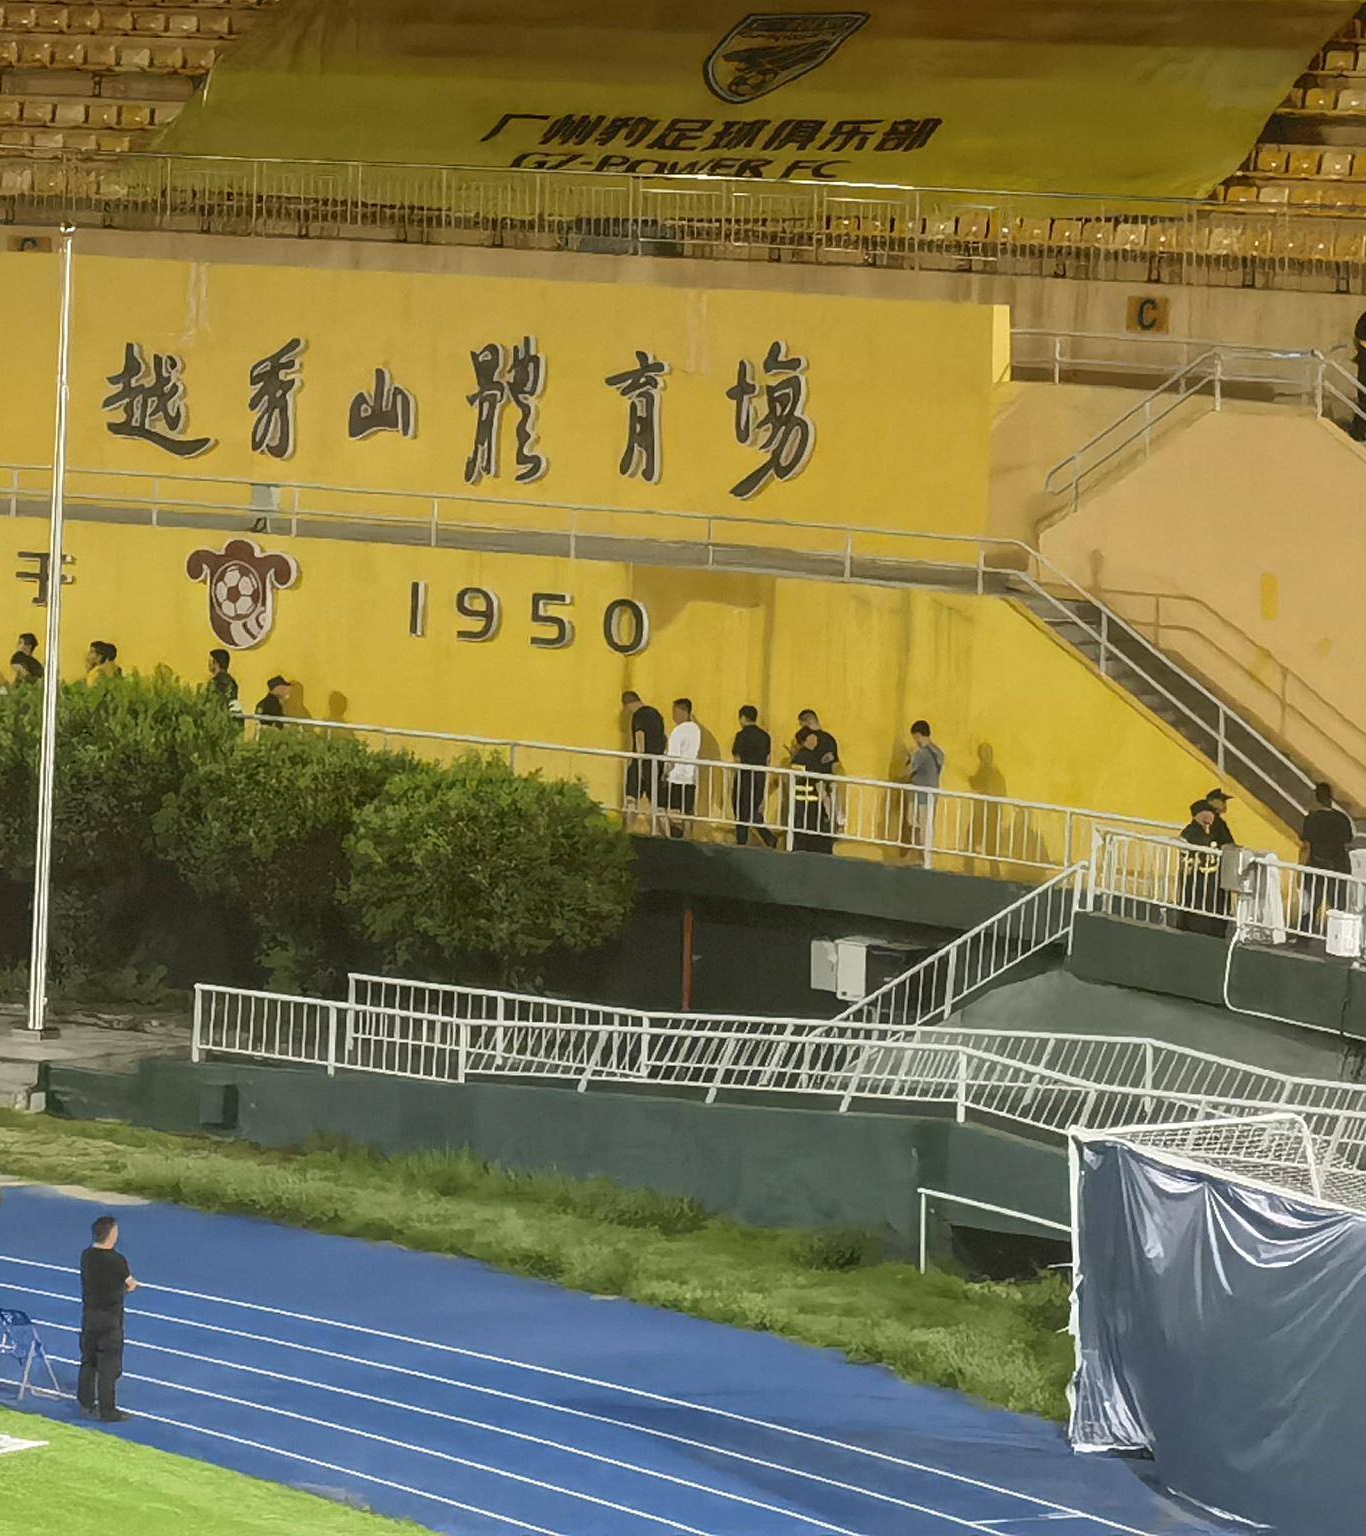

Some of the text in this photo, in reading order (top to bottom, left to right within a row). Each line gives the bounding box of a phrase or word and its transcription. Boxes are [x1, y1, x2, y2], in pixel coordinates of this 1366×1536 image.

[480, 113, 942, 152] 广州豹足球俱乐部
[409, 580, 649, 656] 1950
